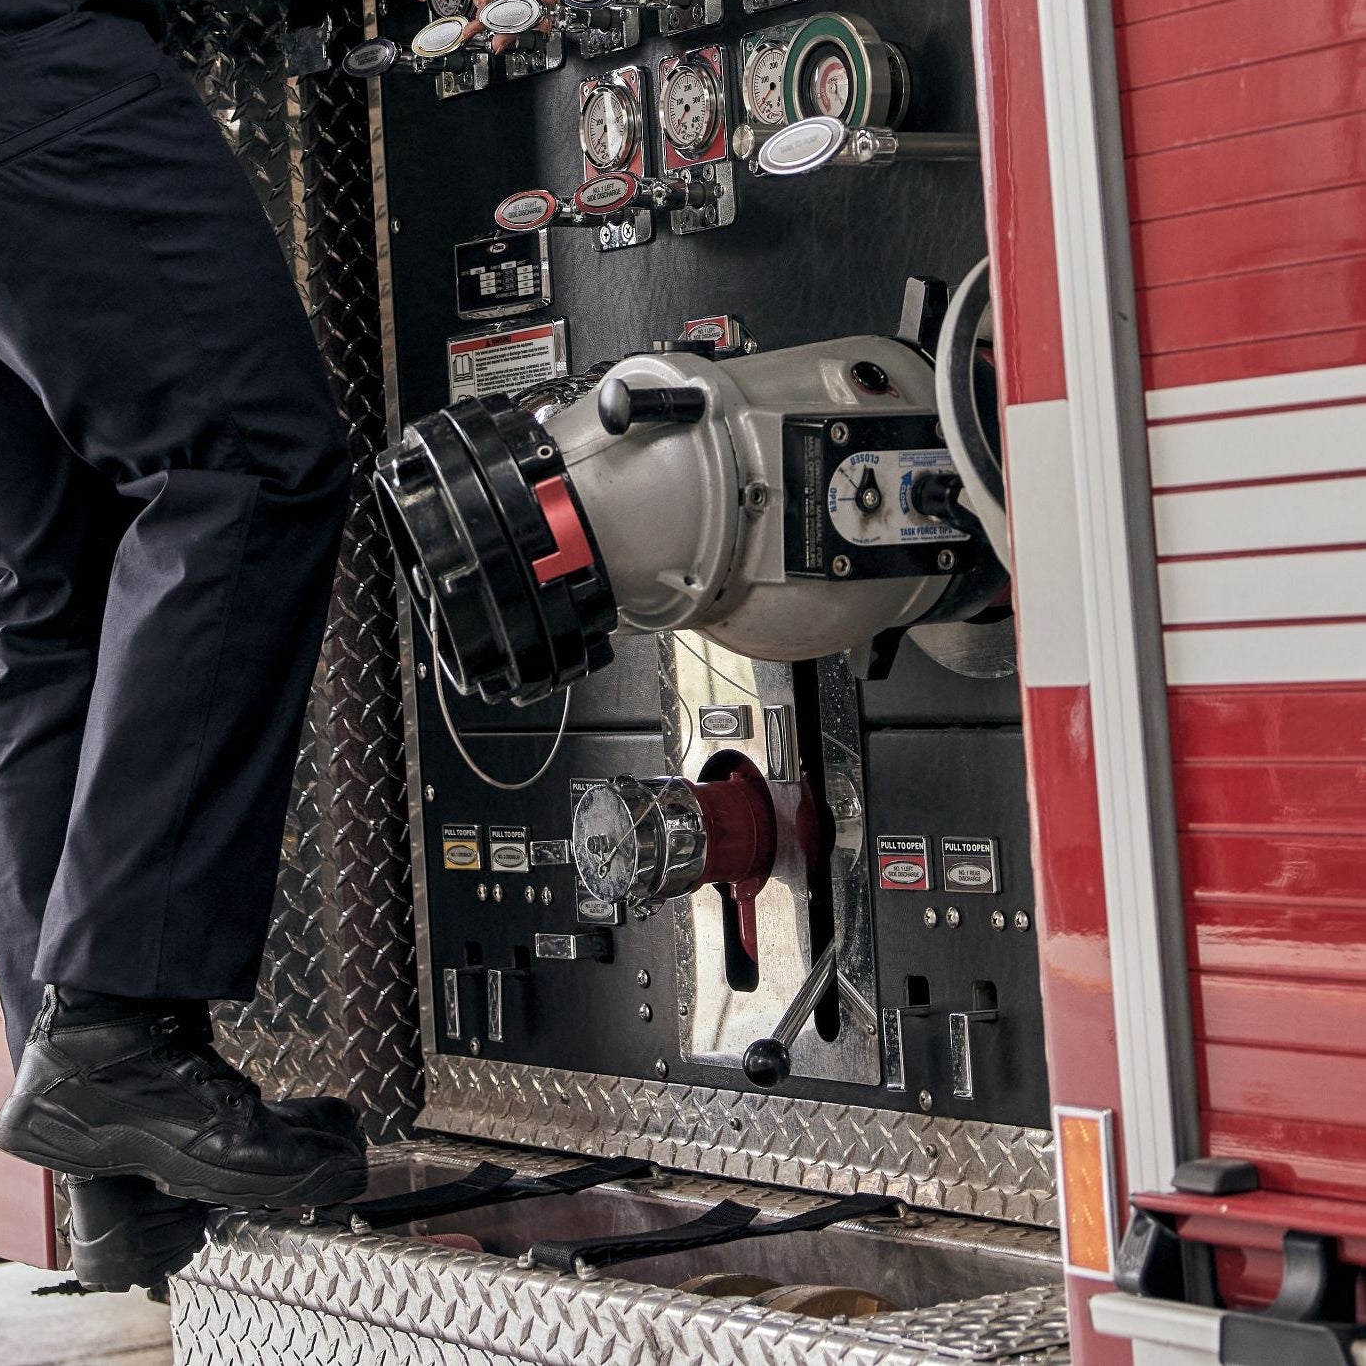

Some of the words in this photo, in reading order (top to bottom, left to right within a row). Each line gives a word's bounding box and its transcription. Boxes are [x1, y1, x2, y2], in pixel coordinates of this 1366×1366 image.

[597, 188, 621, 199] DISCHARGE
[850, 453, 880, 466] CLOSED
[829, 487, 838, 513] OPEN
[900, 527, 915, 536] TASK
[917, 526, 937, 535] FORCE
[939, 525, 953, 533] TIPS
[573, 783, 586, 791] PULL
[880, 841, 897, 850] PULL
[897, 842, 906, 850] TO
[906, 842, 924, 850] OPEN
[944, 843, 962, 851] PULL
[963, 844, 972, 852] TO
[972, 844, 990, 852] OPEN
